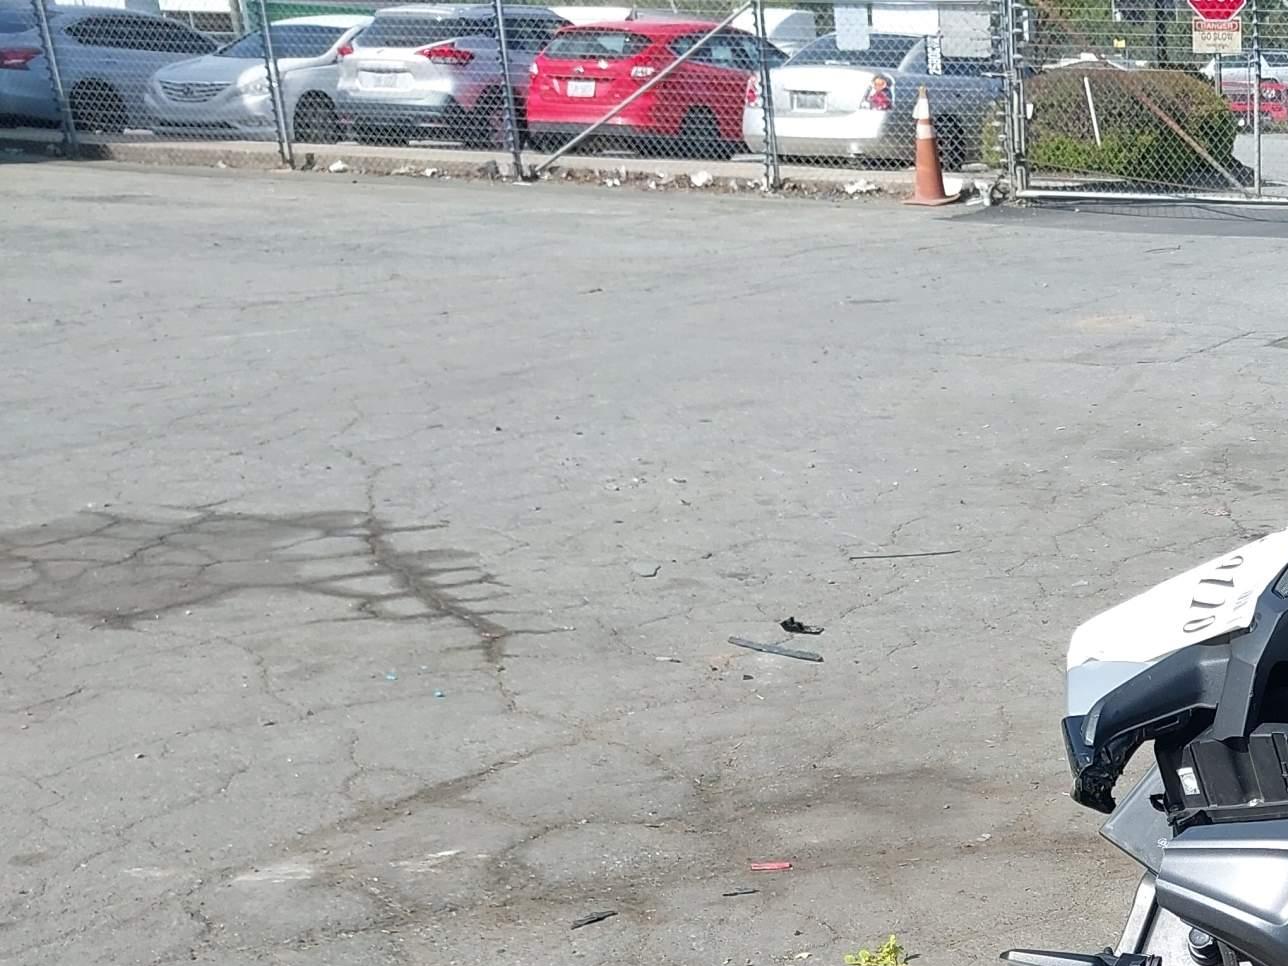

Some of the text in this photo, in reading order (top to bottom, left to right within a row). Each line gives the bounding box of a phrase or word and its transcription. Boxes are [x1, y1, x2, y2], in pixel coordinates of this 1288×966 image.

[1200, 22, 1233, 30] DANGER
[1201, 32, 1233, 41] GO SLOW
